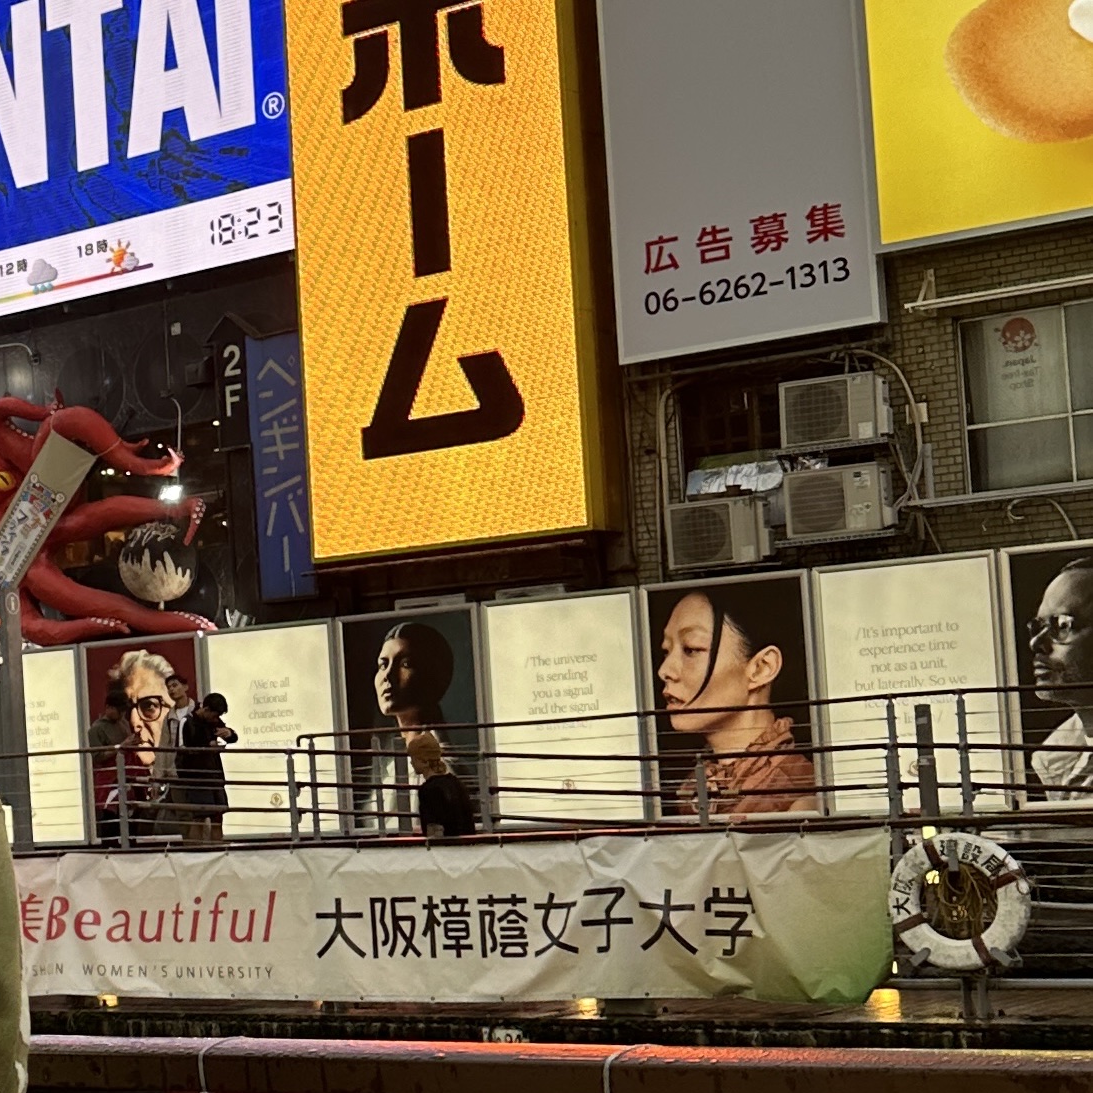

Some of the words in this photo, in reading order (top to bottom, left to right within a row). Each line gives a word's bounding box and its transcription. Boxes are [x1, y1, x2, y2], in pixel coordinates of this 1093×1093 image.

[210, 201, 283, 246] 18:23
[341, 0, 526, 461] ホーム
[643, 202, 847, 276] 広告募集
[76, 239, 109, 259] 18時
[644, 256, 851, 316] 06-6262-1313
[882, 621, 943, 639] important
[946, 621, 959, 632] to
[859, 643, 926, 658] experience
[928, 639, 958, 651] time
[553, 653, 597, 665] universe
[536, 672, 545, 682] is
[546, 669, 588, 682] sending
[871, 663, 891, 674] not
[894, 662, 907, 672] as
[910, 662, 917, 671] a
[854, 679, 875, 692] but
[929, 675, 946, 687] So
[253, 692, 288, 705] fictional
[532, 689, 553, 702] you
[554, 689, 561, 697] a
[563, 683, 594, 699] signal
[248, 709, 294, 720] characters
[528, 703, 548, 715] and
[550, 703, 567, 714] the
[569, 699, 599, 714] signal
[260, 722, 302, 733] collective
[175, 966, 273, 979] UNIVERSITY
